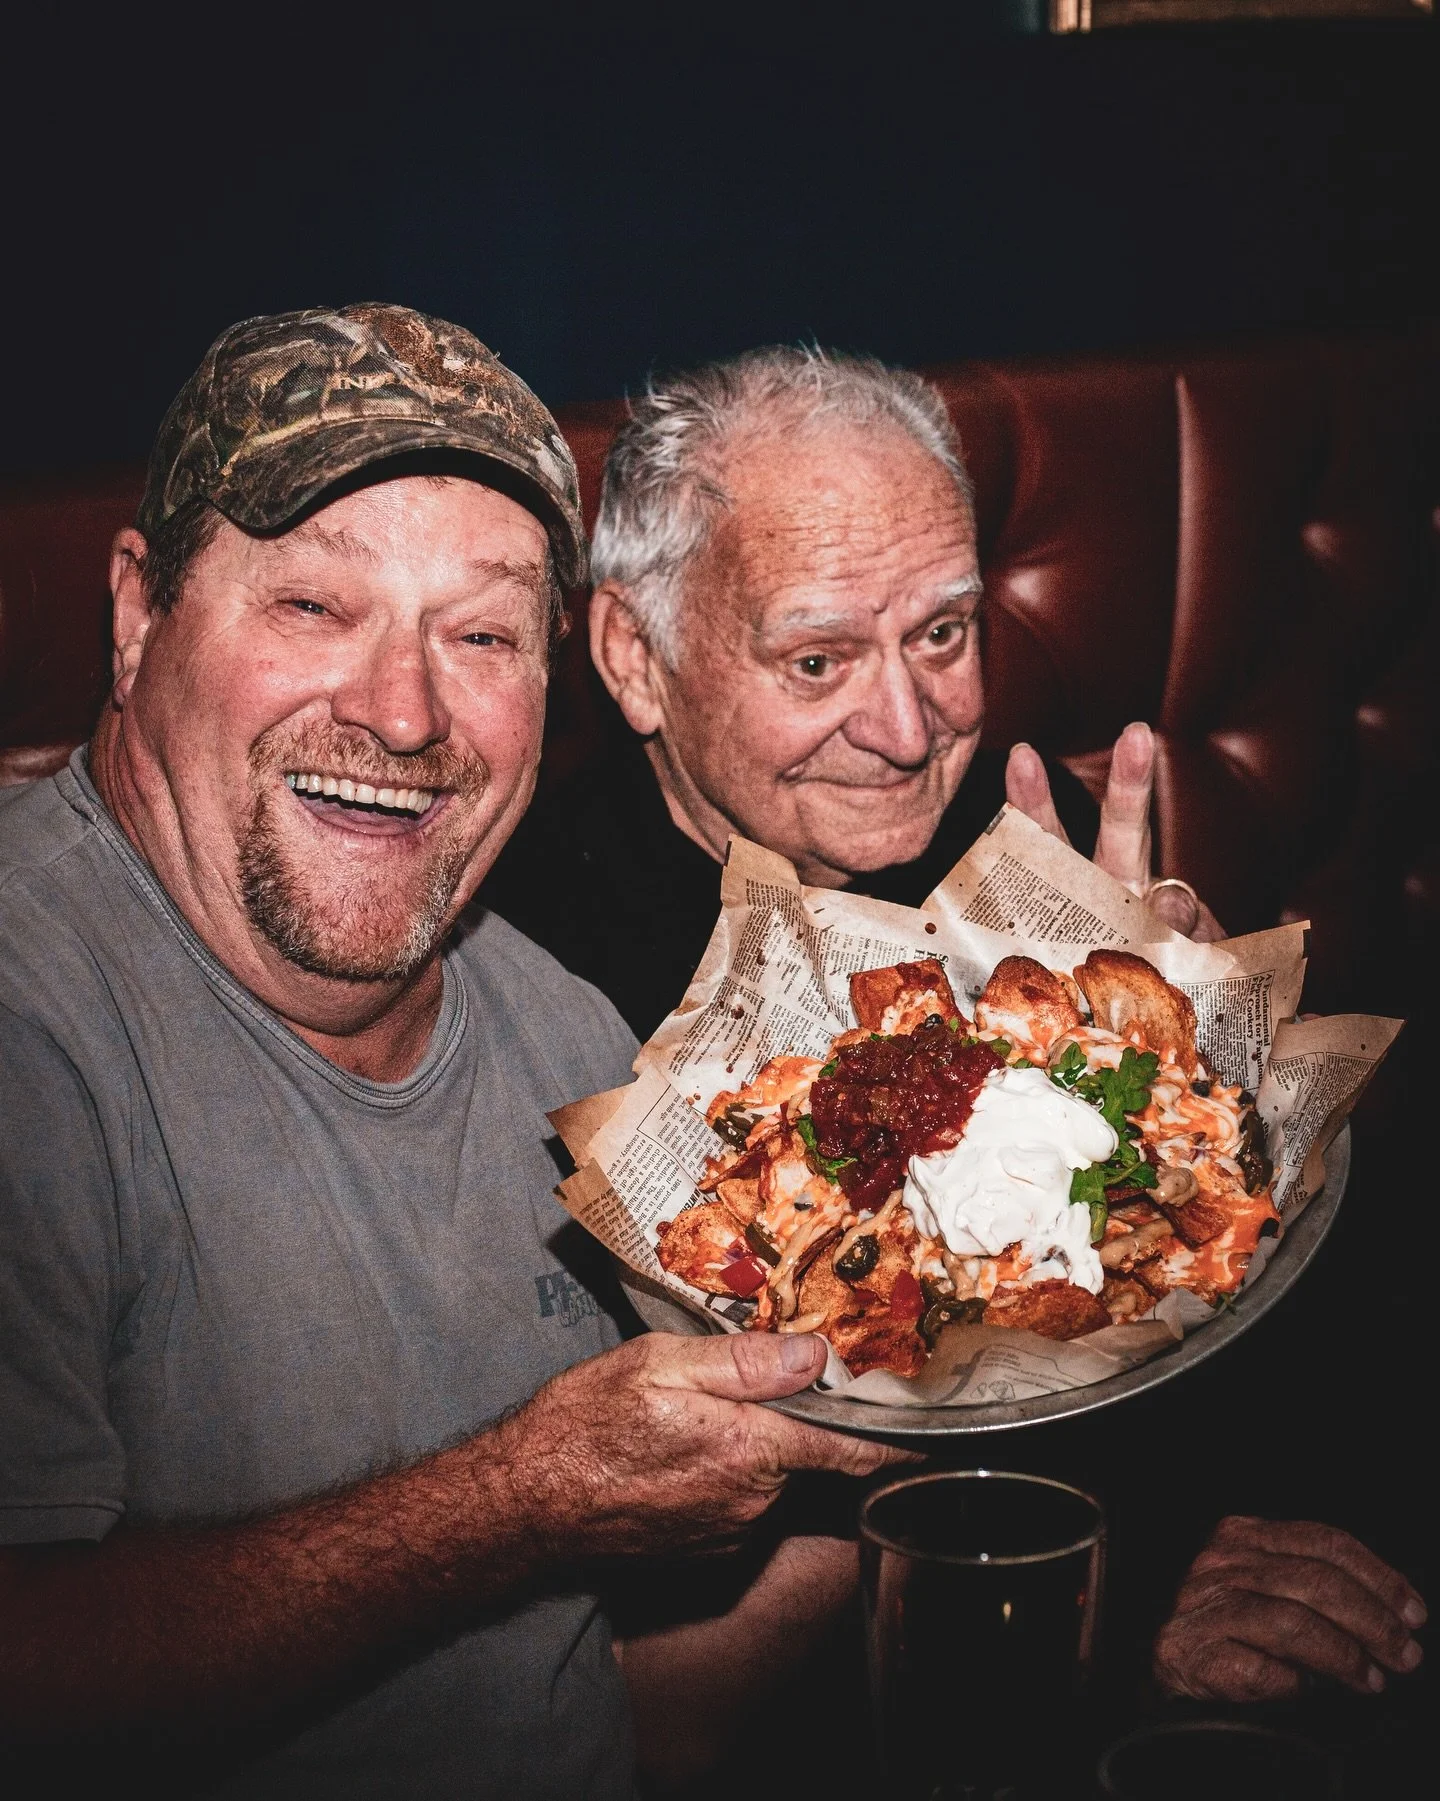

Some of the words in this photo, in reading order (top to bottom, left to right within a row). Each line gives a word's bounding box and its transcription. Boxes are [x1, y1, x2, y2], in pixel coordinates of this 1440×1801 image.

[1040, 916, 1058, 939] Sandwich
[1246, 998, 1254, 1039] Cookery
[671, 1111, 679, 1119] the
[678, 1115, 686, 1124] the
[617, 1133, 641, 1159] category,
[636, 1143, 655, 1165] catches
[616, 1158, 634, 1178] catches
[641, 1147, 662, 1171] cluding
[686, 1160, 695, 1169] for
[604, 1162, 619, 1177] good
[624, 1164, 639, 1179] right
[654, 1159, 675, 1184] Paradise.
[619, 1179, 629, 1188] off
[634, 1170, 656, 1196] abundant
[645, 1184, 657, 1196] The
[669, 1178, 682, 1192] 1989
[632, 1196, 648, 1214] month
[654, 1189, 672, 1210] proved
